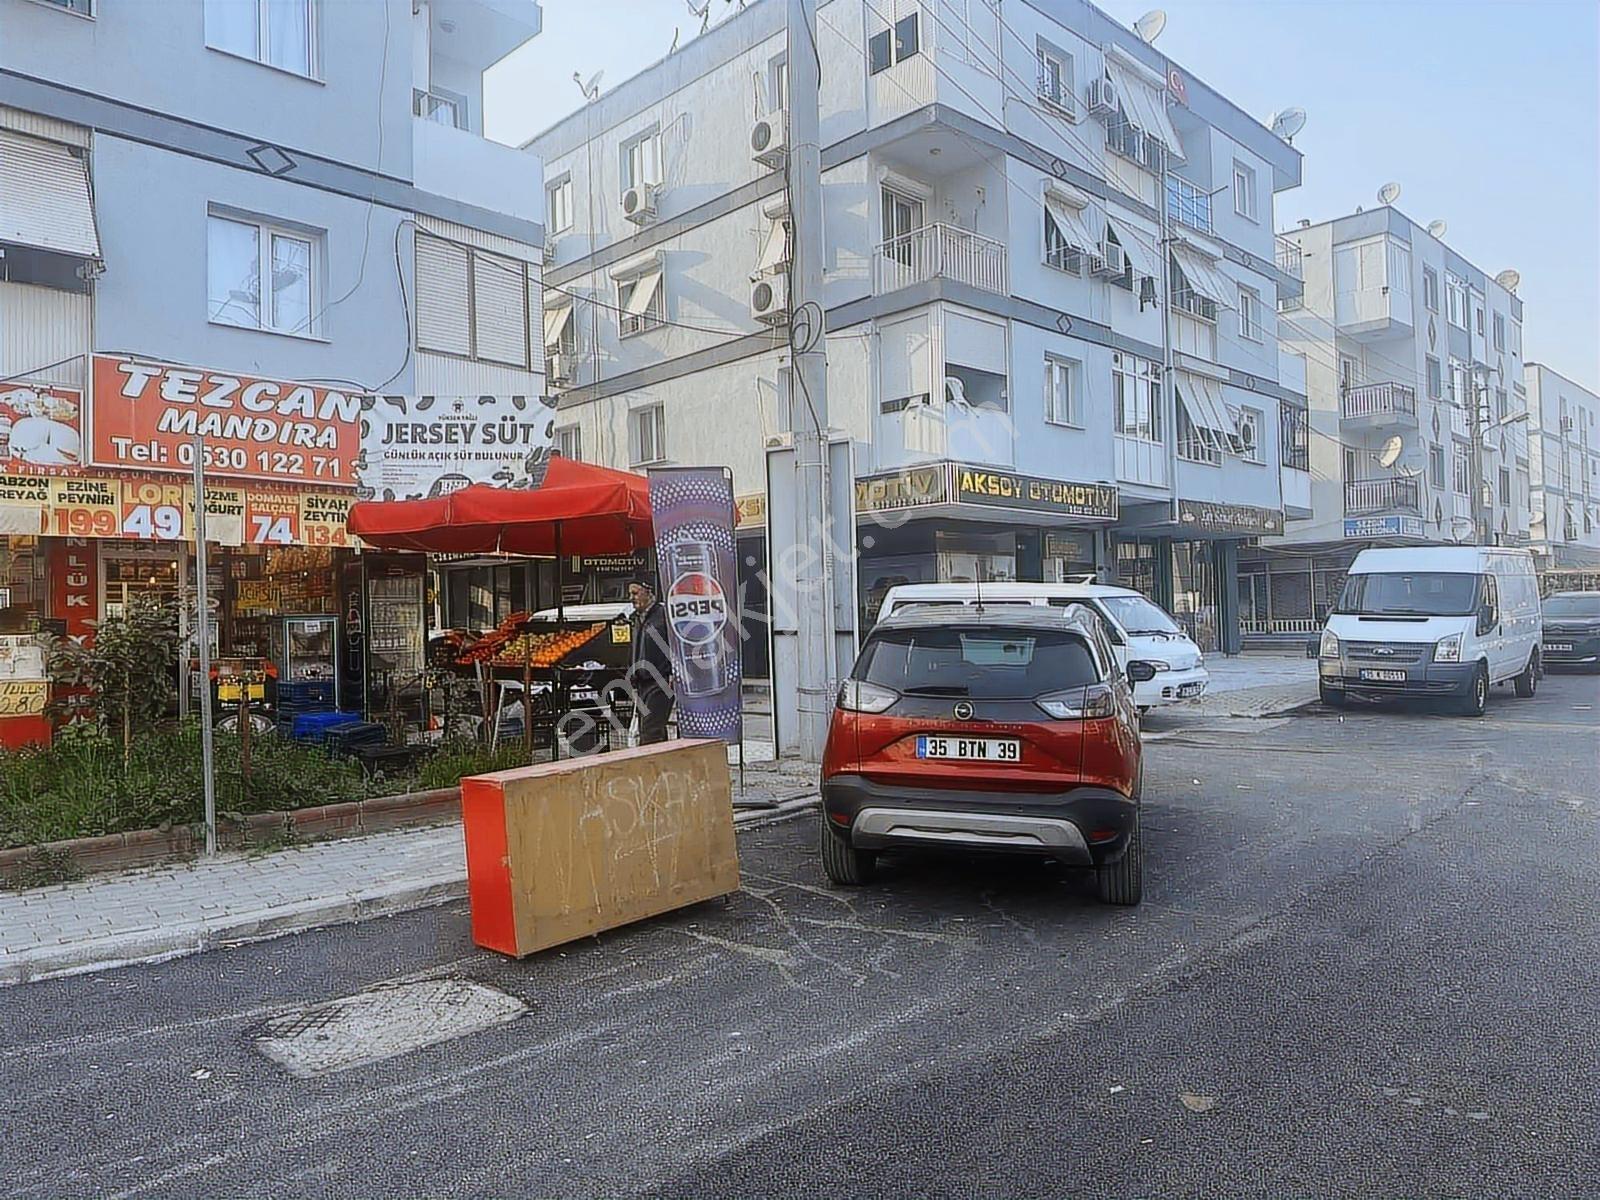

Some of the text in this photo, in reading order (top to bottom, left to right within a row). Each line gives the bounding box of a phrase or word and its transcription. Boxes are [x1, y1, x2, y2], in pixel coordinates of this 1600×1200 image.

[117, 362, 361, 423] TEZCAN
[157, 407, 337, 449] MANDIRA
[381, 415, 534, 445] JERSEY SÜT
[111, 437, 168, 463] Tel:
[177, 442, 248, 470] 0530
[257, 451, 304, 476] 122
[311, 455, 340, 478] 71
[384, 449, 427, 460] GÜNLÜK
[453, 449, 473, 460] SÜT
[475, 451, 524, 461] BULUNUR
[66, 479, 108, 493] EZİNE
[123, 482, 182, 505] LOR
[194, 487, 239, 501] ÜZME
[961, 471, 1022, 499] AKSOY
[58, 492, 114, 505] PEYNİRİ
[188, 501, 244, 515] YĞURT
[307, 495, 348, 510] SİYAH
[54, 507, 116, 536] 199
[123, 505, 181, 539] 49
[252, 515, 292, 544] 74
[305, 525, 346, 545] 134
[929, 739, 1017, 759] 35 BTN 39
